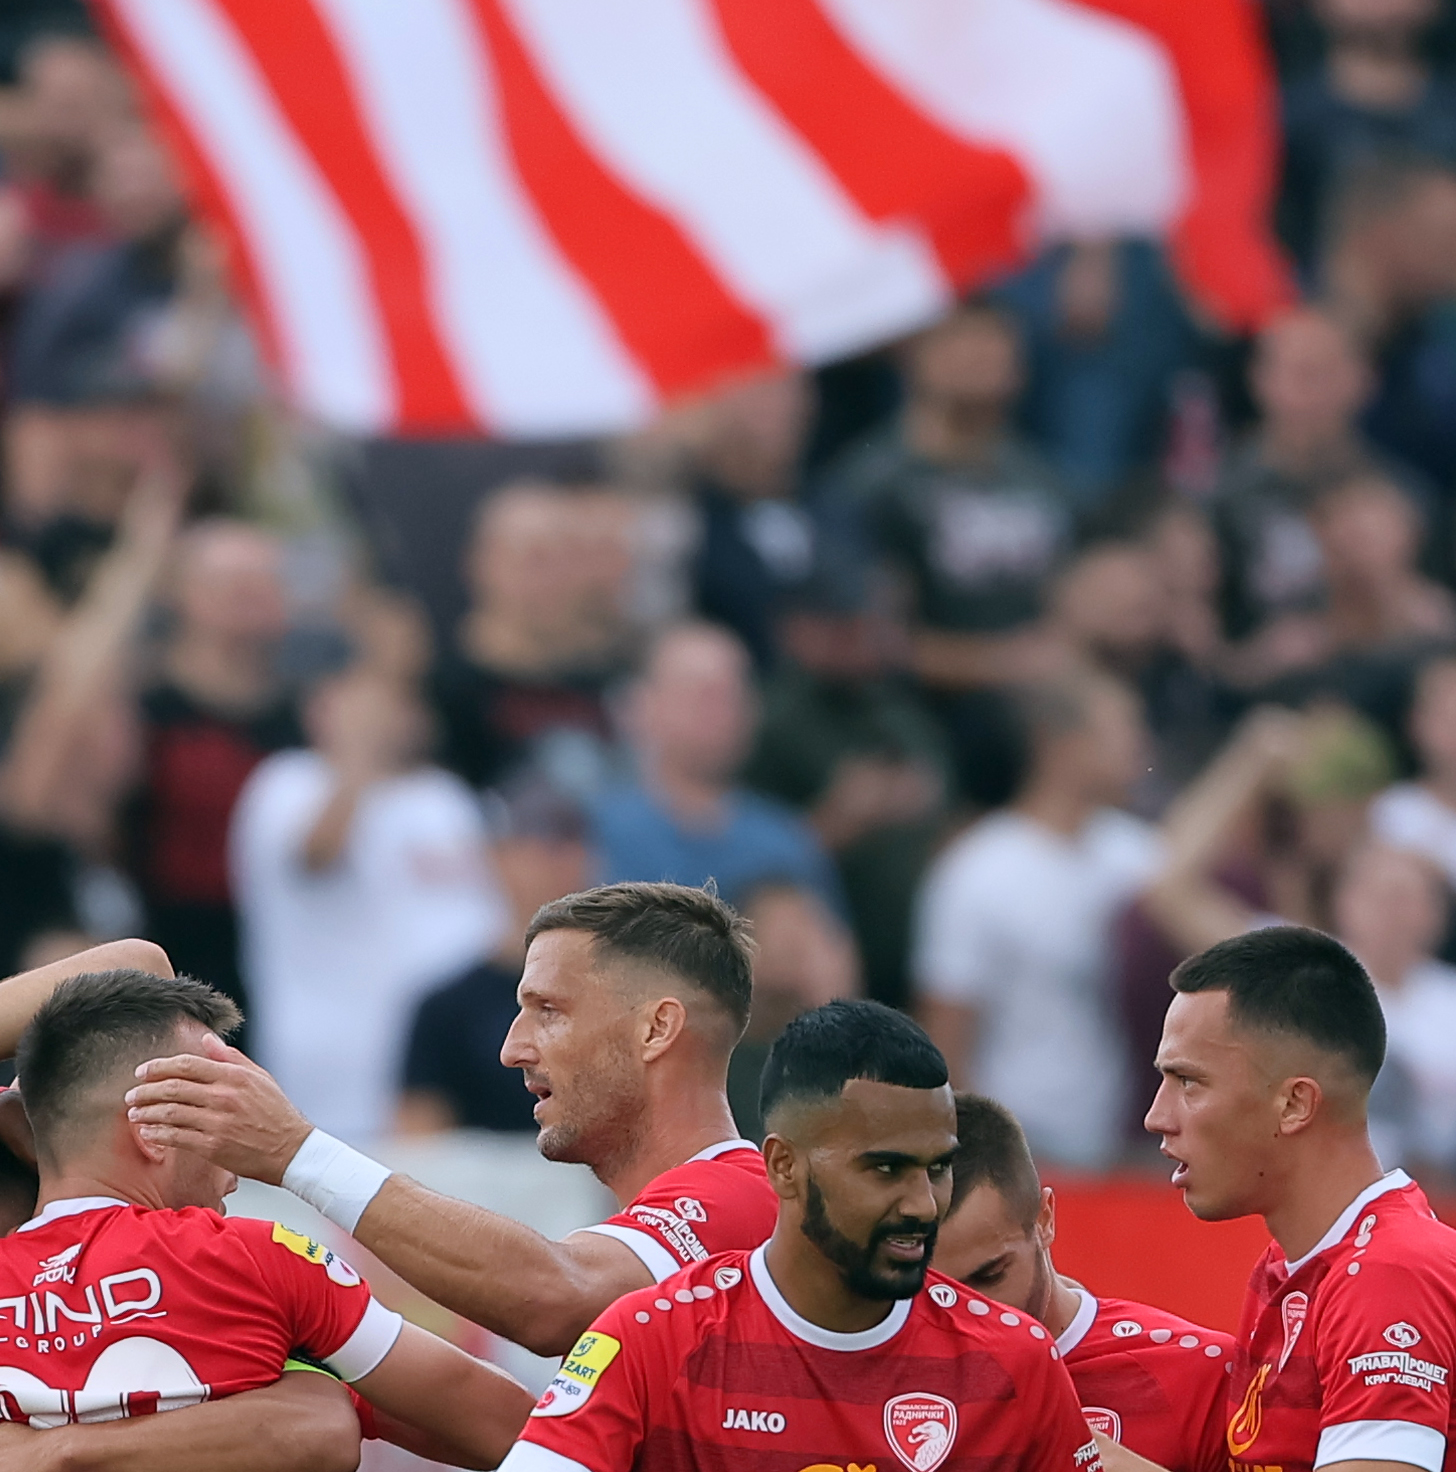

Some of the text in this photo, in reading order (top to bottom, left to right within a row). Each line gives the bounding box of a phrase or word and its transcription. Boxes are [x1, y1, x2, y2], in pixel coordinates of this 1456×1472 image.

[15, 1324, 103, 1353] GROUP
[565, 1360, 597, 1380] ZART
[722, 1408, 786, 1434] JAKO
